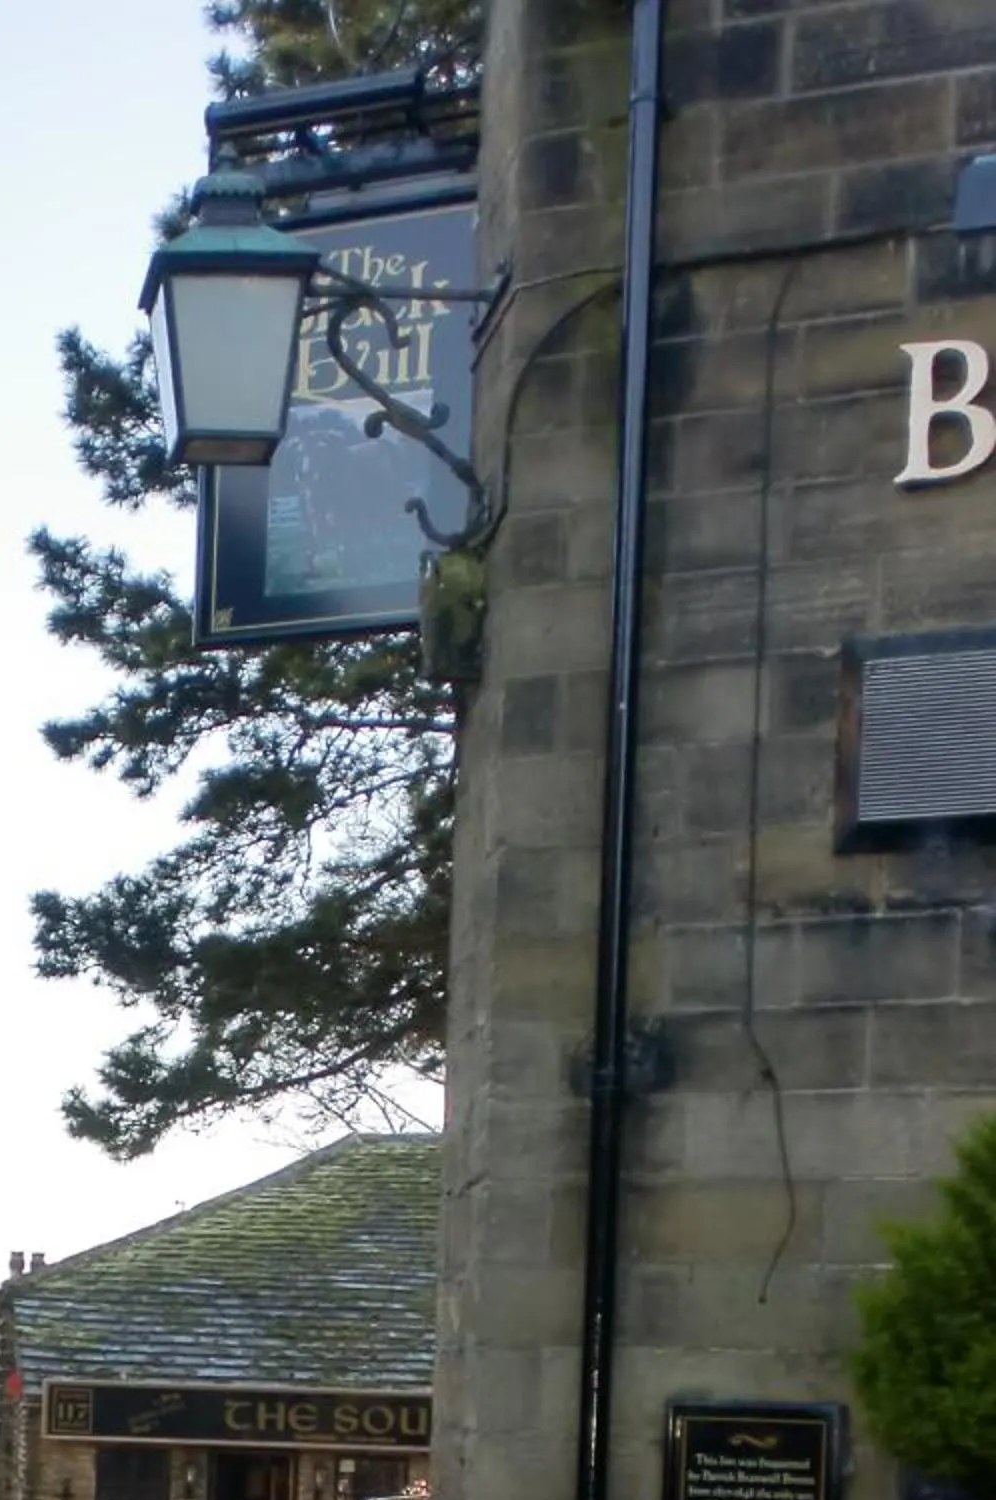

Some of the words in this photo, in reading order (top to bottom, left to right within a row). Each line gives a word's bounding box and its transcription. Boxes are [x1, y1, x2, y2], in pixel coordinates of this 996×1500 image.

[328, 245, 406, 288] The
[893, 340, 996, 483] B
[223, 1399, 319, 1432] THE
